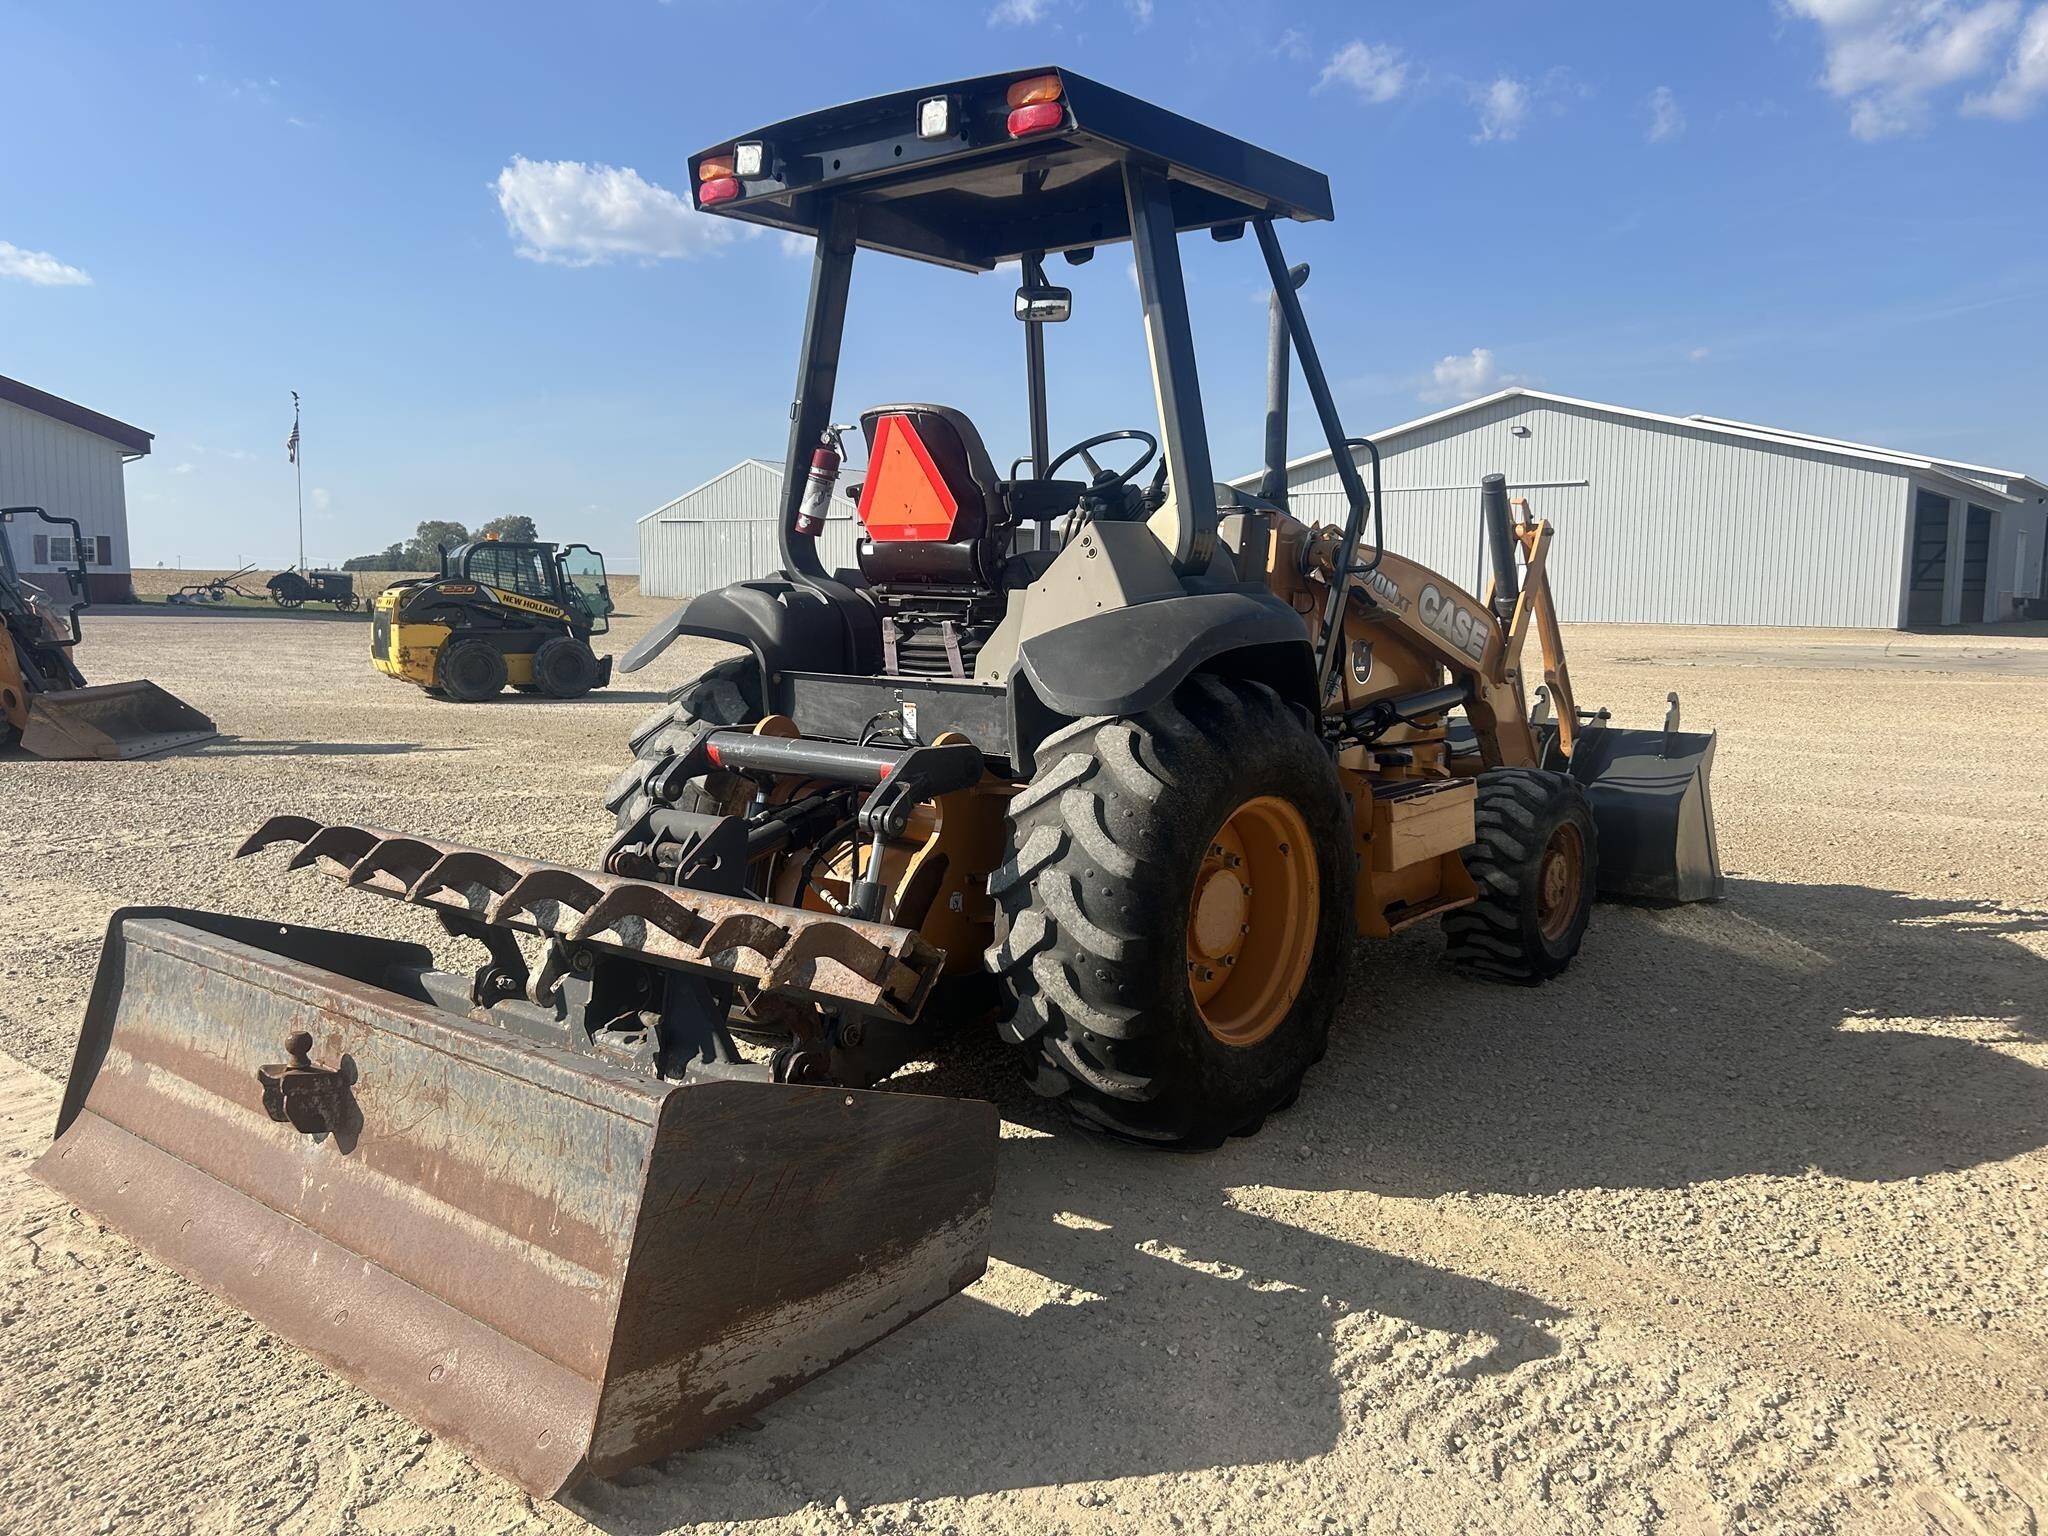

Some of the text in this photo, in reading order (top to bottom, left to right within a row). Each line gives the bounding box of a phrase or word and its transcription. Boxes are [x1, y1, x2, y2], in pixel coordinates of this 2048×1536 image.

[503, 594, 561, 616] NEW HOLLAND
[1419, 584, 1488, 661] CASE
